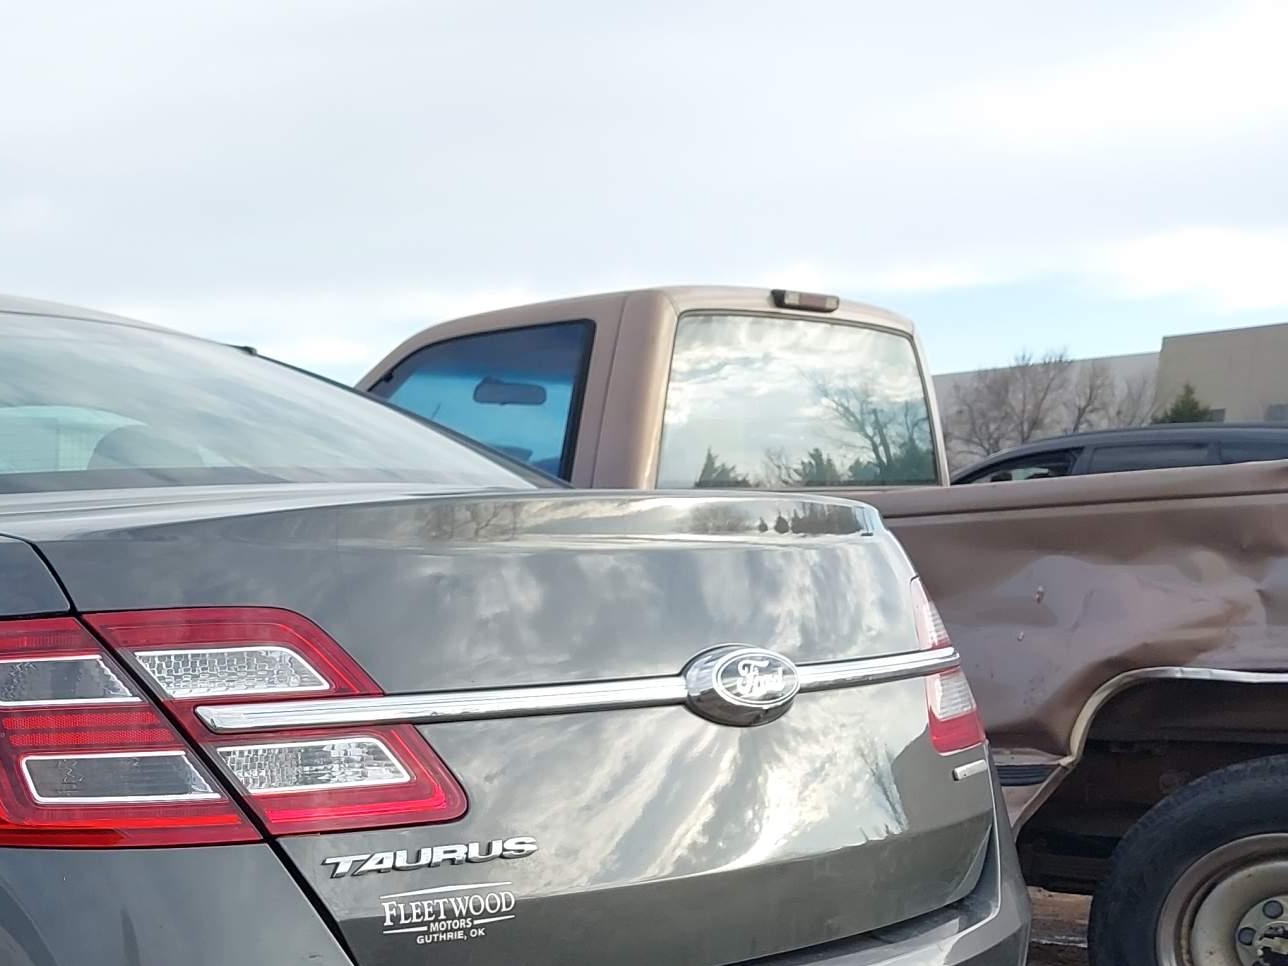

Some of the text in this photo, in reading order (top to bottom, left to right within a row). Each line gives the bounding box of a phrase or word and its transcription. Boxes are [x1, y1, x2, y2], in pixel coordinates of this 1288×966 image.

[733, 660, 785, 698] Ford
[322, 836, 539, 878] TAURUS
[381, 891, 516, 927] FLEETWOOD
[429, 917, 473, 933] MOTORS
[415, 927, 487, 945] GUTHRIE, OK
